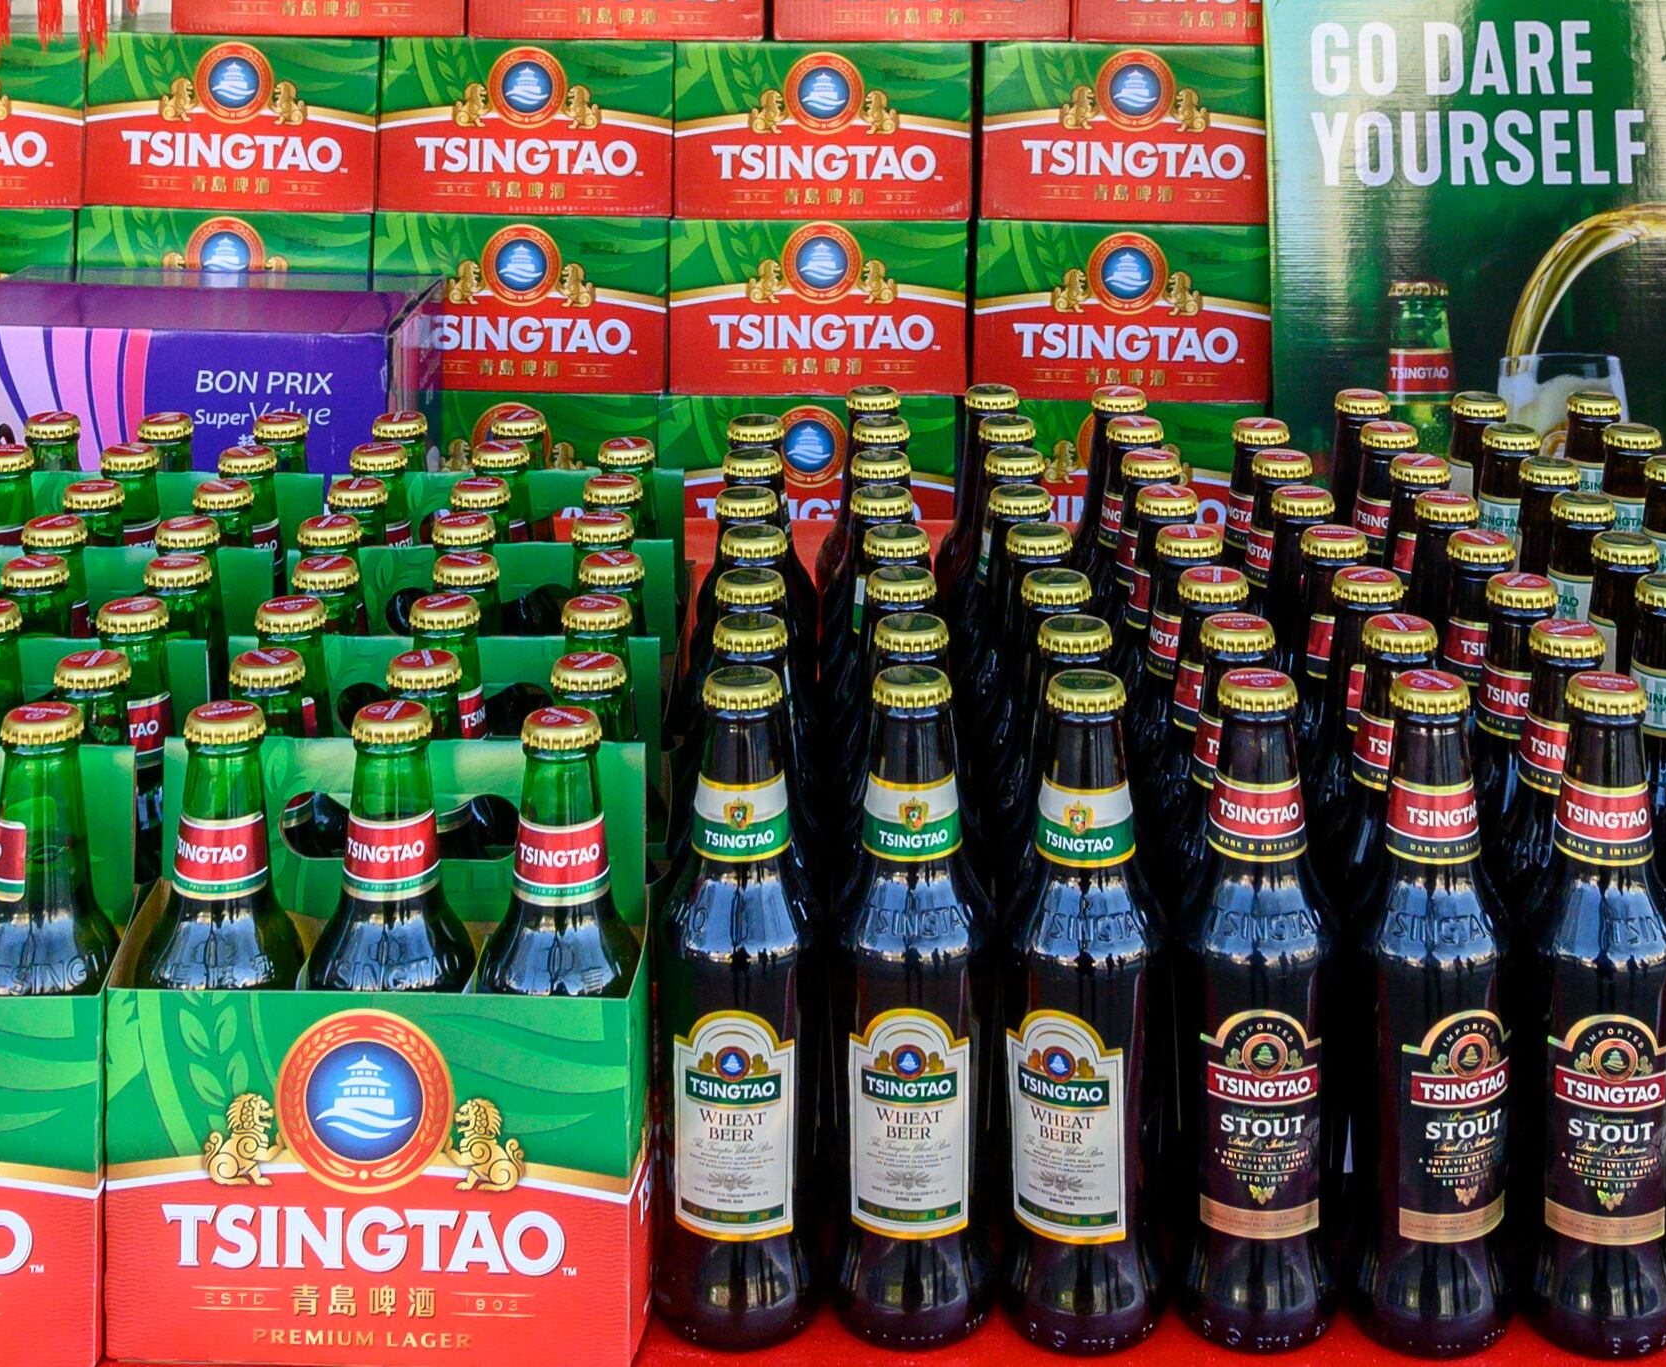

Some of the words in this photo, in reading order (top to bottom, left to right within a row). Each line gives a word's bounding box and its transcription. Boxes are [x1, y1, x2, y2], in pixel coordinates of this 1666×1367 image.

[1310, 21, 1399, 96] GO
[1422, 20, 1593, 96] DARE
[1311, 108, 1646, 188] YOURSELF
[712, 143, 937, 182] TSINGTAO
[783, 187, 863, 205] 青島啤酒
[1013, 321, 1240, 362] TSINGTAO
[782, 358, 862, 376] 青島啤酒
[1390, 365, 1449, 379] TSINGTAO
[196, 370, 258, 393] BON
[266, 371, 333, 395] PRIX
[1219, 798, 1299, 824] TSINGTAO
[704, 827, 775, 848] TSINGTAO
[1219, 834, 1248, 850] DARK
[520, 842, 599, 868] TSINGTAO
[1236, 1023, 1294, 1043] IMPORTED
[1585, 1028, 1644, 1048] IMPORTED
[689, 1075, 776, 1100] TSINGTAO
[865, 1075, 952, 1098] TSINGTAO
[1215, 1073, 1310, 1098] TSINGTAO
[1563, 1077, 1660, 1104] TSINGTAO
[698, 1107, 767, 1128] WHEAT
[1220, 1114, 1305, 1137] STOUT
[708, 1125, 754, 1142] BEER
[1568, 1118, 1654, 1143] STOUT
[161, 1203, 566, 1276] TSINGTAO
[289, 1284, 437, 1319] 青島啤酒
